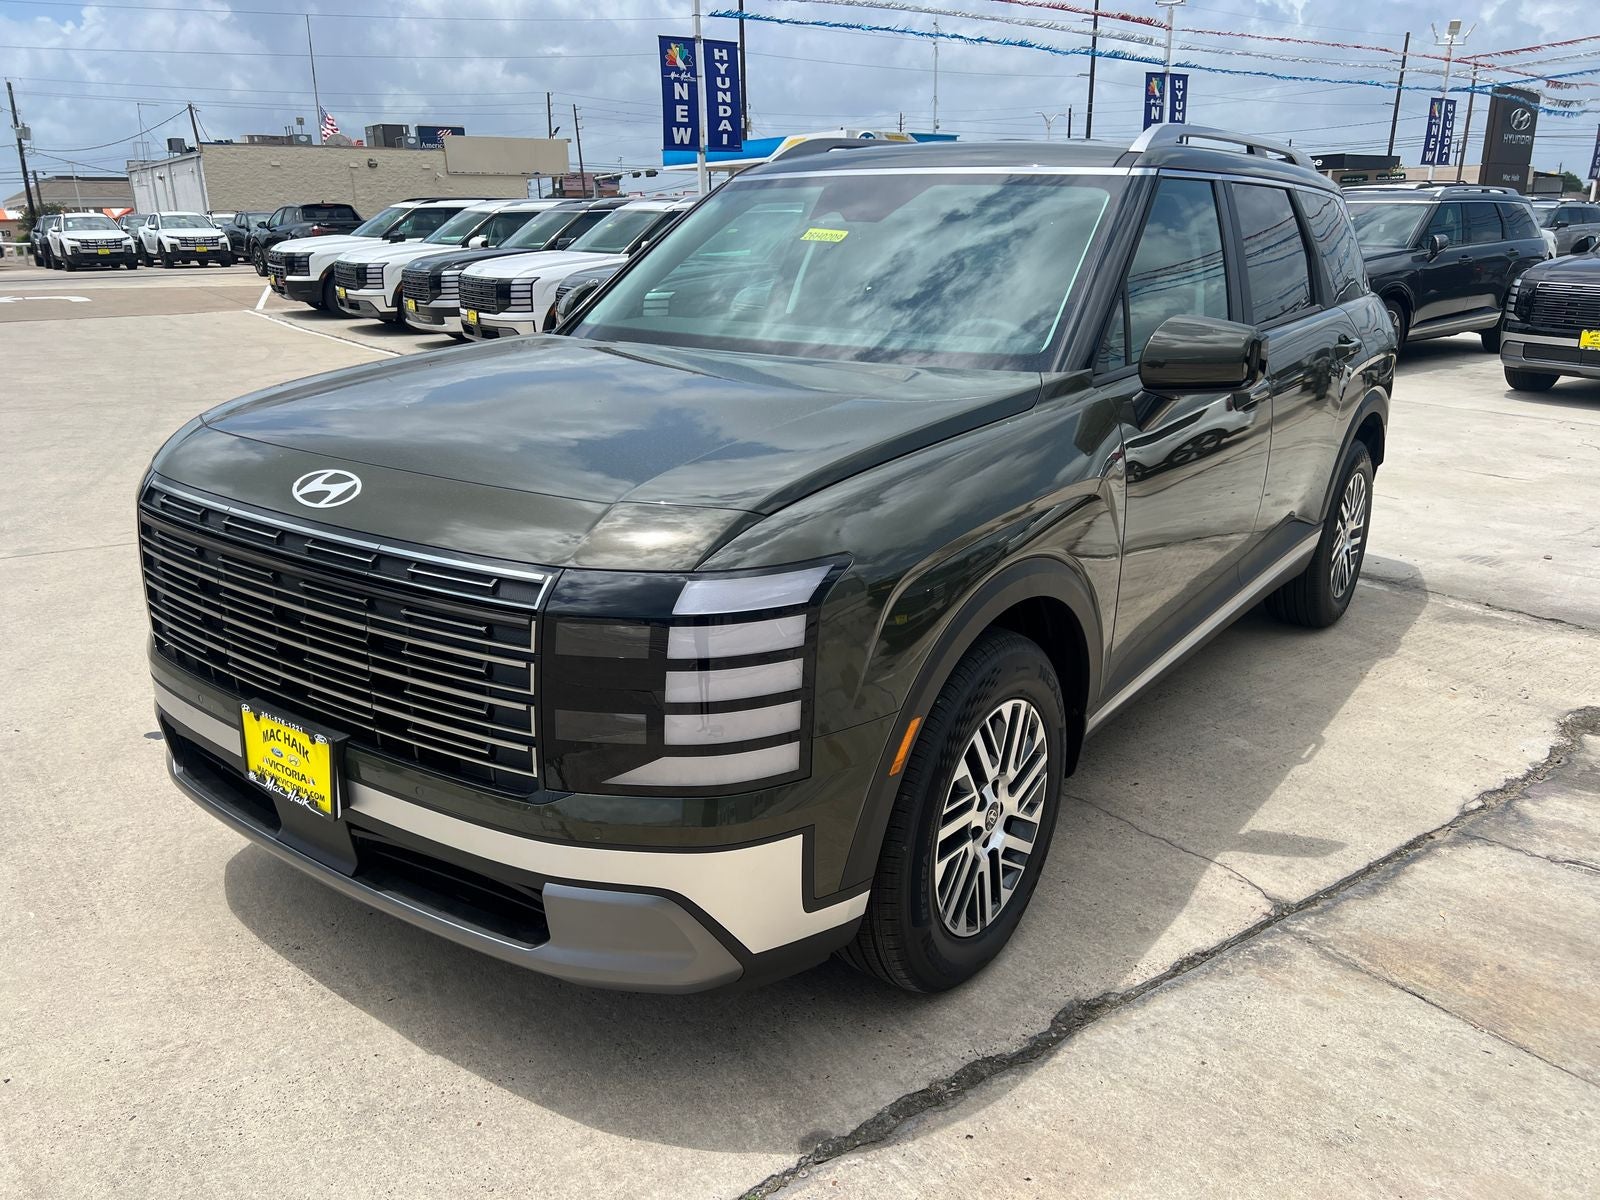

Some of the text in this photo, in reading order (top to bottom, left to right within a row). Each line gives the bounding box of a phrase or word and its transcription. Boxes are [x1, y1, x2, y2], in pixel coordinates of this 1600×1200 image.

[672, 82, 692, 145] NEW
[713, 48, 733, 145] HYUNDAI
[1425, 125, 1438, 162] NEW
[1442, 104, 1453, 162] HYUNDAI
[1503, 133, 1532, 145] HYUNDAI
[262, 728, 282, 743] MAC
[283, 732, 311, 763] HAIK
[264, 777, 286, 795] Mac
[267, 757, 308, 782] VICTORIA
